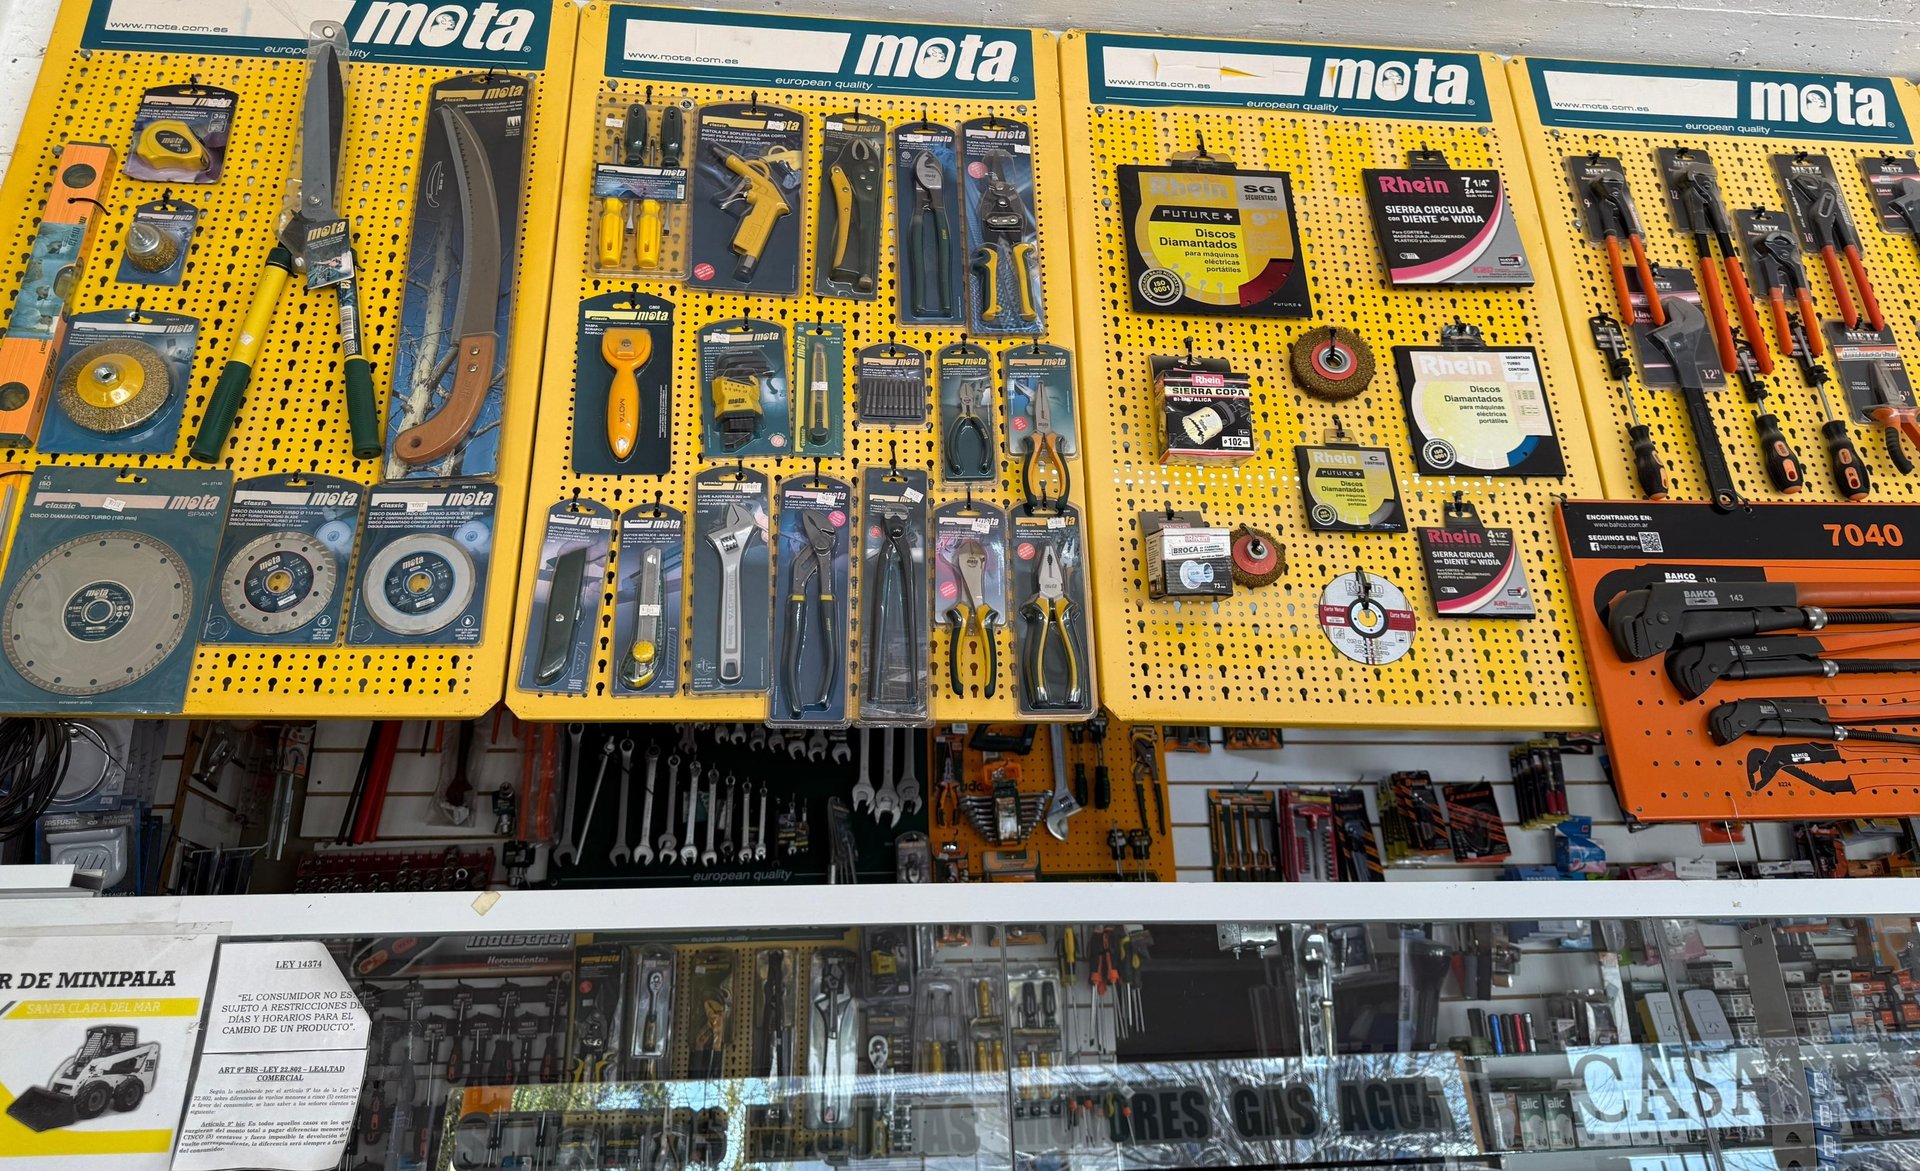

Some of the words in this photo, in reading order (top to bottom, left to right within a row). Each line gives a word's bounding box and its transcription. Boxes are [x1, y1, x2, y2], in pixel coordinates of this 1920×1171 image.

[110, 22, 228, 33] www.mota.com.es
[352, 1, 535, 51] mota
[627, 52, 739, 65] www.mota.com.es
[854, 34, 1018, 83] mota
[775, 76, 831, 89] european
[834, 79, 874, 91] quality
[1108, 78, 1211, 89] www.mota.com.es
[1320, 58, 1468, 104] mota
[485, 84, 524, 100] mota
[1247, 100, 1300, 111] european
[1302, 102, 1339, 112] quality
[1554, 101, 1649, 112] www.mota.com.es
[1750, 81, 1886, 127] mota
[1685, 122, 1734, 133] european
[1737, 125, 1770, 134] quality
[931, 135, 952, 143] mota
[997, 129, 1026, 139] mota
[662, 169, 686, 177] mota
[1150, 176, 1228, 198] Rhein
[1378, 176, 1449, 193] Rhein
[1461, 177, 1470, 188] 7
[1244, 185, 1276, 194] SG
[1162, 209, 1220, 221] FUTURE
[1385, 206, 1422, 214] SIERRA
[1424, 206, 1475, 214] CIRCULAR
[306, 221, 347, 241] mota
[1195, 229, 1236, 239] Discos
[1159, 237, 1237, 249] Diamantados
[1203, 250, 1239, 259] máquinas
[1154, 285, 1170, 293] 9001
[637, 311, 669, 320] mota
[166, 324, 194, 334] mota
[754, 331, 779, 341] mota
[1846, 332, 1881, 341] METZ
[797, 336, 805, 357] mota
[897, 358, 920, 366] mota
[1043, 358, 1067, 366] mota
[1419, 355, 1494, 376] Rhein
[1196, 376, 1220, 384] Rhein
[1444, 395, 1503, 403] Diamantados
[1228, 438, 1242, 446] 102
[1313, 451, 1357, 464] Rhein
[169, 495, 220, 510] mota
[309, 491, 358, 506] mota
[446, 491, 493, 505] mota
[653, 520, 680, 529] mota
[1427, 529, 1481, 544] Rhein
[1487, 530, 1495, 539] 4
[1823, 524, 1904, 547] 7040
[260, 555, 281, 571] mota
[402, 556, 424, 570] mota
[86, 589, 109, 597] mota
[1684, 590, 1715, 598] BAHCO
[693, 871, 750, 882] european
[753, 869, 792, 881] quality
[276, 961, 295, 969] LEY
[298, 960, 322, 968] 14374
[487, 955, 549, 965] Herramientas
[0, 974, 12, 989] R
[17, 972, 53, 989] DE
[56, 970, 176, 989] MINIPALA
[256, 992, 321, 1001] CONSUMIDOR
[27, 1003, 65, 1015] SANTA
[69, 1002, 107, 1013] CLARA
[110, 1002, 130, 1013] DEL
[133, 1001, 160, 1012] MAR
[222, 1004, 259, 1013] SUJETO
[271, 1002, 347, 1011] RESTRICCIONES
[228, 1014, 251, 1023] DÍAS
[262, 1013, 312, 1022] HORARIOS
[314, 1013, 338, 1021] PARA
[341, 1012, 354, 1020] EL
[222, 1026, 260, 1034] CAMBIO
[1521, 1098, 1539, 1109] alic
[1548, 1097, 1566, 1109] alic
[1235, 1087, 1315, 1139] GAS
